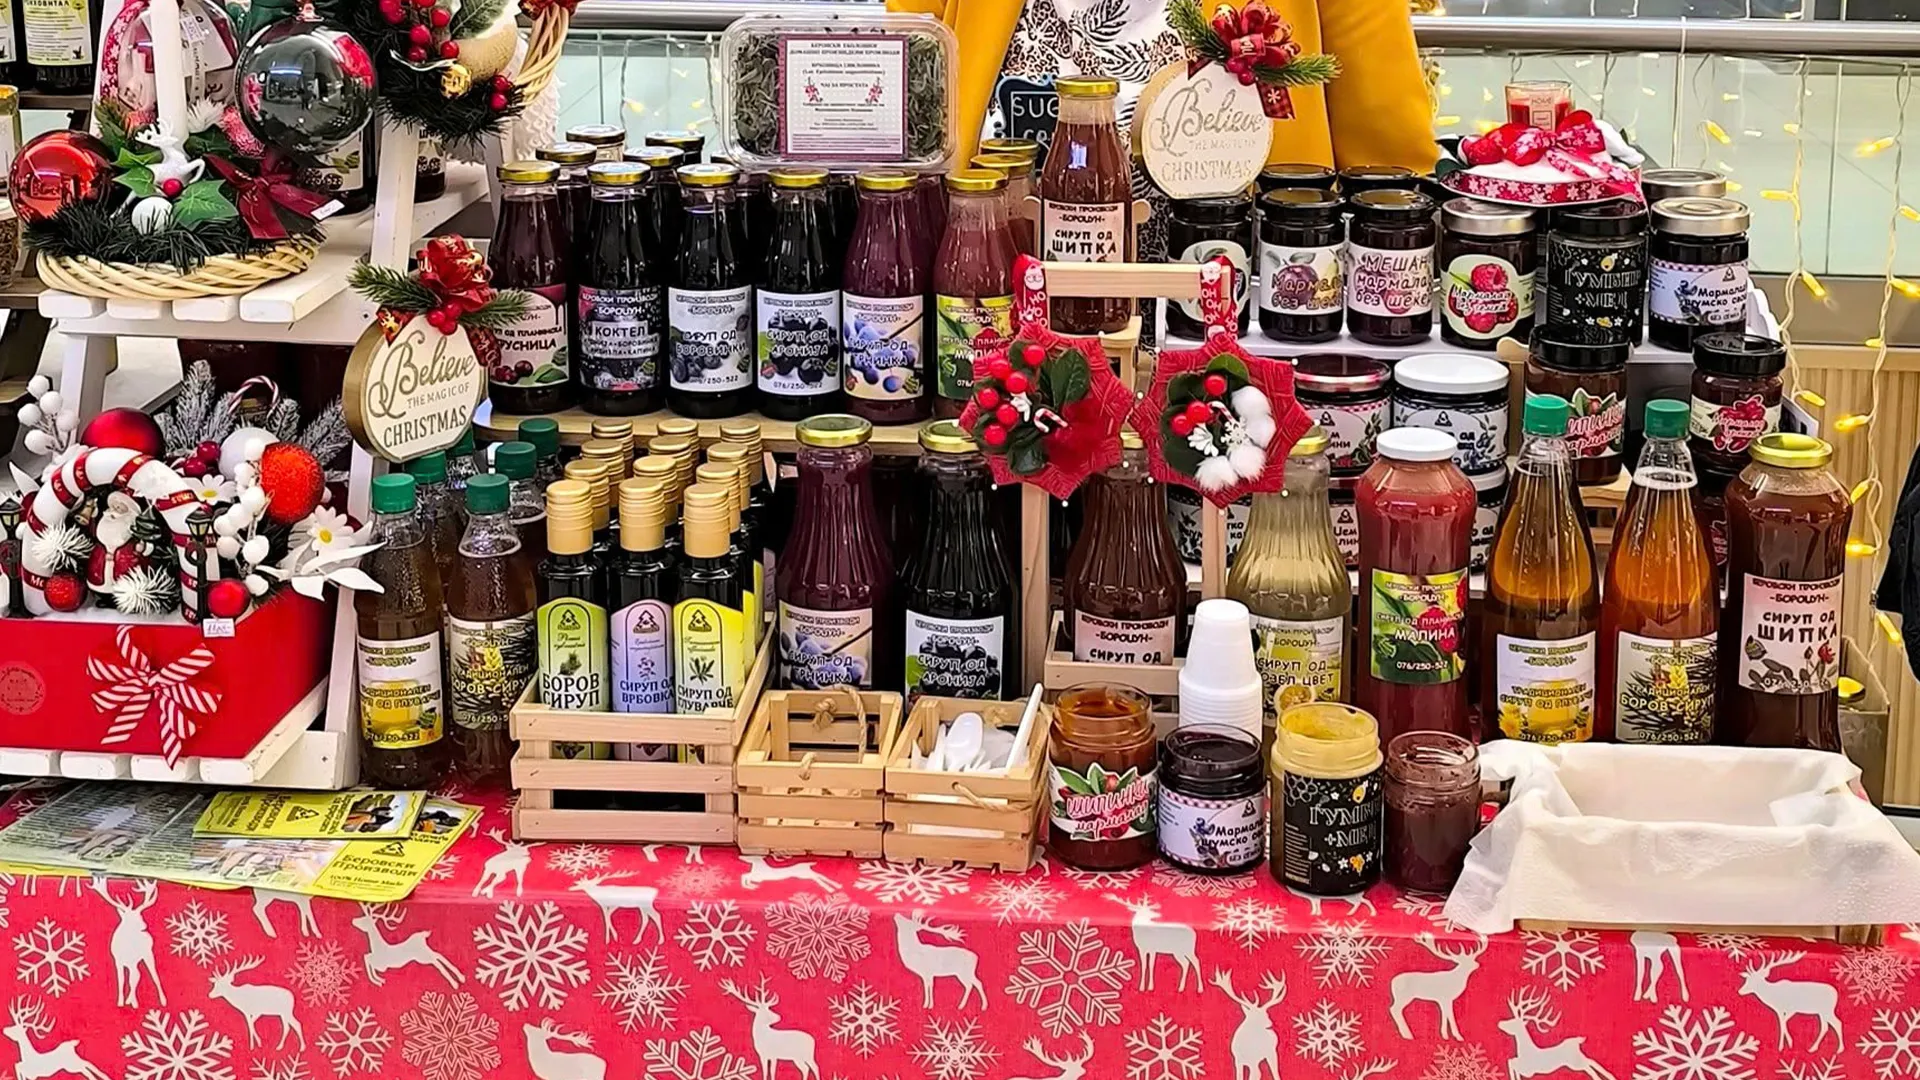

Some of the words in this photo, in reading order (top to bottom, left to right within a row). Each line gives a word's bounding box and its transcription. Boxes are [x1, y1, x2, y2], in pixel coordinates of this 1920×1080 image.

[1150, 78, 1265, 156] Believe
[1162, 160, 1252, 182] CHRISTMAS
[1055, 229, 1091, 240] СИРУП
[1097, 231, 1112, 240] ОД
[1052, 239, 1116, 254] ШИПКА
[1356, 288, 1380, 306] без
[595, 326, 645, 337] КОКТЕЛ
[721, 330, 736, 341] ОД
[766, 329, 806, 343] СИРУП
[811, 329, 829, 341] ОД
[676, 342, 746, 356] БОРОВИНКИ
[771, 344, 829, 357] АРОНИЈА
[890, 341, 908, 351] ОД
[368, 330, 476, 419] Believe
[407, 395, 426, 409] THE
[427, 386, 456, 403] MAGIC
[459, 382, 470, 394] OF
[383, 405, 467, 448] CHRISTMAS
[1763, 612, 1813, 624] СИРУП
[1820, 610, 1835, 623] ОД
[1395, 627, 1455, 641] МАЛИНА
[1758, 623, 1837, 643] ШИПКА
[833, 656, 853, 666] ОД
[917, 654, 960, 671] СИРУП
[966, 659, 987, 671] ОД
[1090, 648, 1135, 663] СИРУП
[1143, 652, 1161, 664] ОД
[1257, 657, 1301, 671] СИРУП
[1308, 660, 1326, 672] ОД
[543, 672, 600, 692] БОРОВ
[619, 680, 658, 692] СИРУП
[922, 671, 985, 686] АРОНИЈА
[1302, 673, 1334, 686] ЦВЕТ
[622, 689, 674, 704] ВРБОВКА
[677, 684, 712, 699] СИРУП
[716, 686, 732, 699] ОД
[1631, 684, 1710, 696] ТРАДИЦИОНАЛЕН
[376, 699, 392, 709] ОД
[543, 690, 600, 709] СИРУП
[1535, 699, 1552, 709] ОД
[1621, 693, 1668, 711] БОРОВ
[1676, 694, 1714, 711] СИРУП
[1639, 731, 1699, 741] 076/250-522
[333, 861, 418, 876] Производи
[342, 854, 416, 869] Беровски
